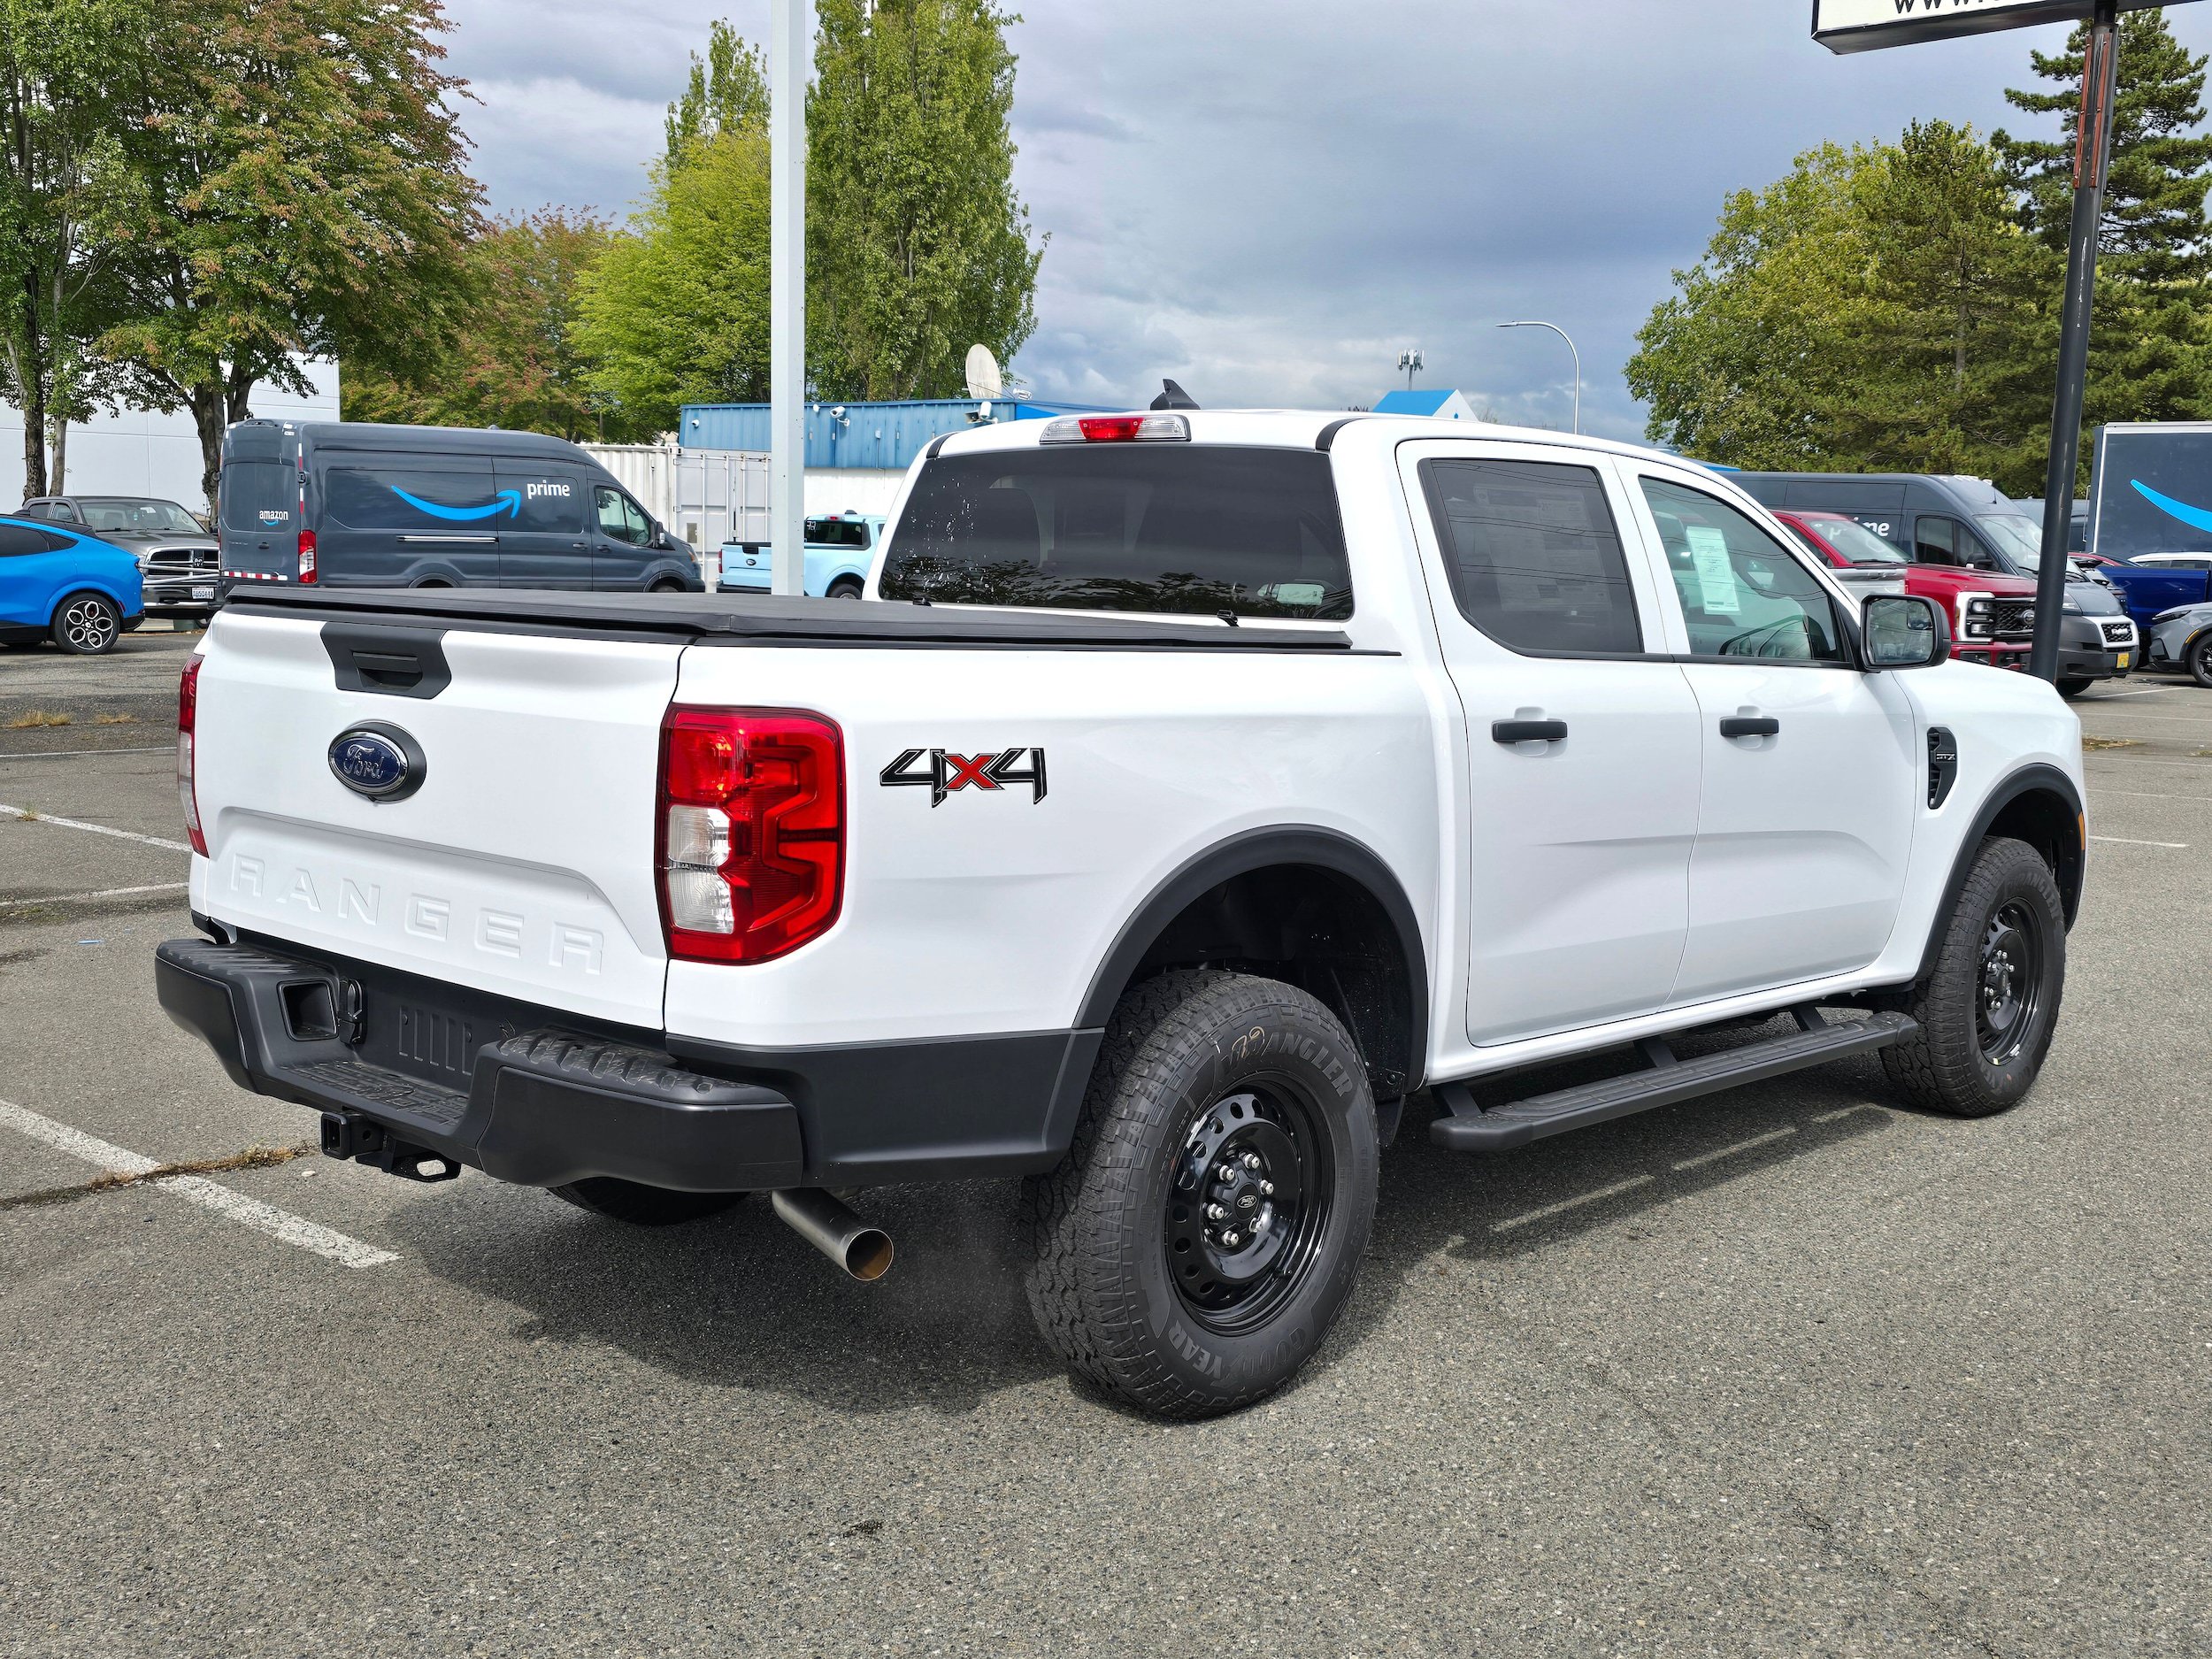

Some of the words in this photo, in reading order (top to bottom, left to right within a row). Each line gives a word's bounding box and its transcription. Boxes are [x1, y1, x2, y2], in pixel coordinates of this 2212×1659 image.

[526, 479, 571, 500] prime
[258, 510, 288, 521] amazon
[343, 743, 386, 780] Ford
[229, 852, 604, 975] RANGER
